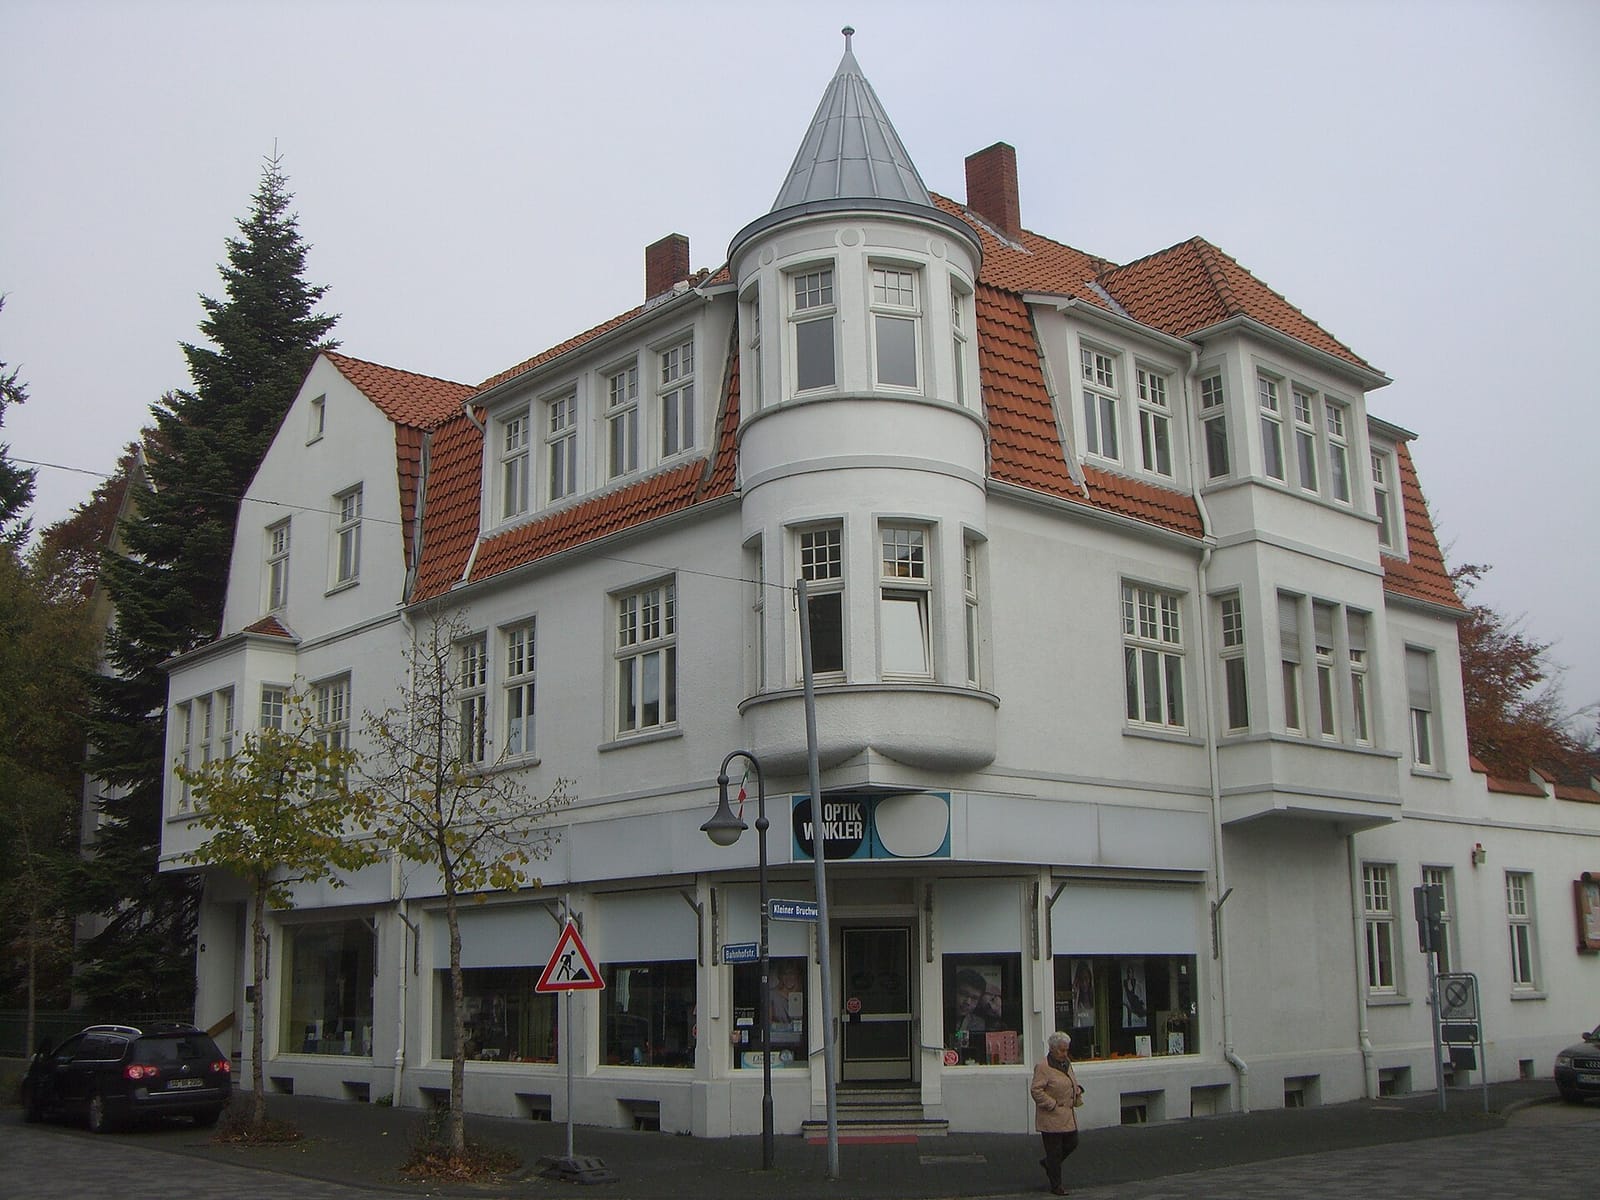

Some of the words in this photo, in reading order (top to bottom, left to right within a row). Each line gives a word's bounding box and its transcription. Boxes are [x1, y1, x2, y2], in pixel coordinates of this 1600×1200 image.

[824, 802, 862, 821] OPTIK
[803, 821, 863, 840] WNKLER
[773, 904, 794, 914] Kleiner
[726, 949, 756, 959] Bahnhofstr.
